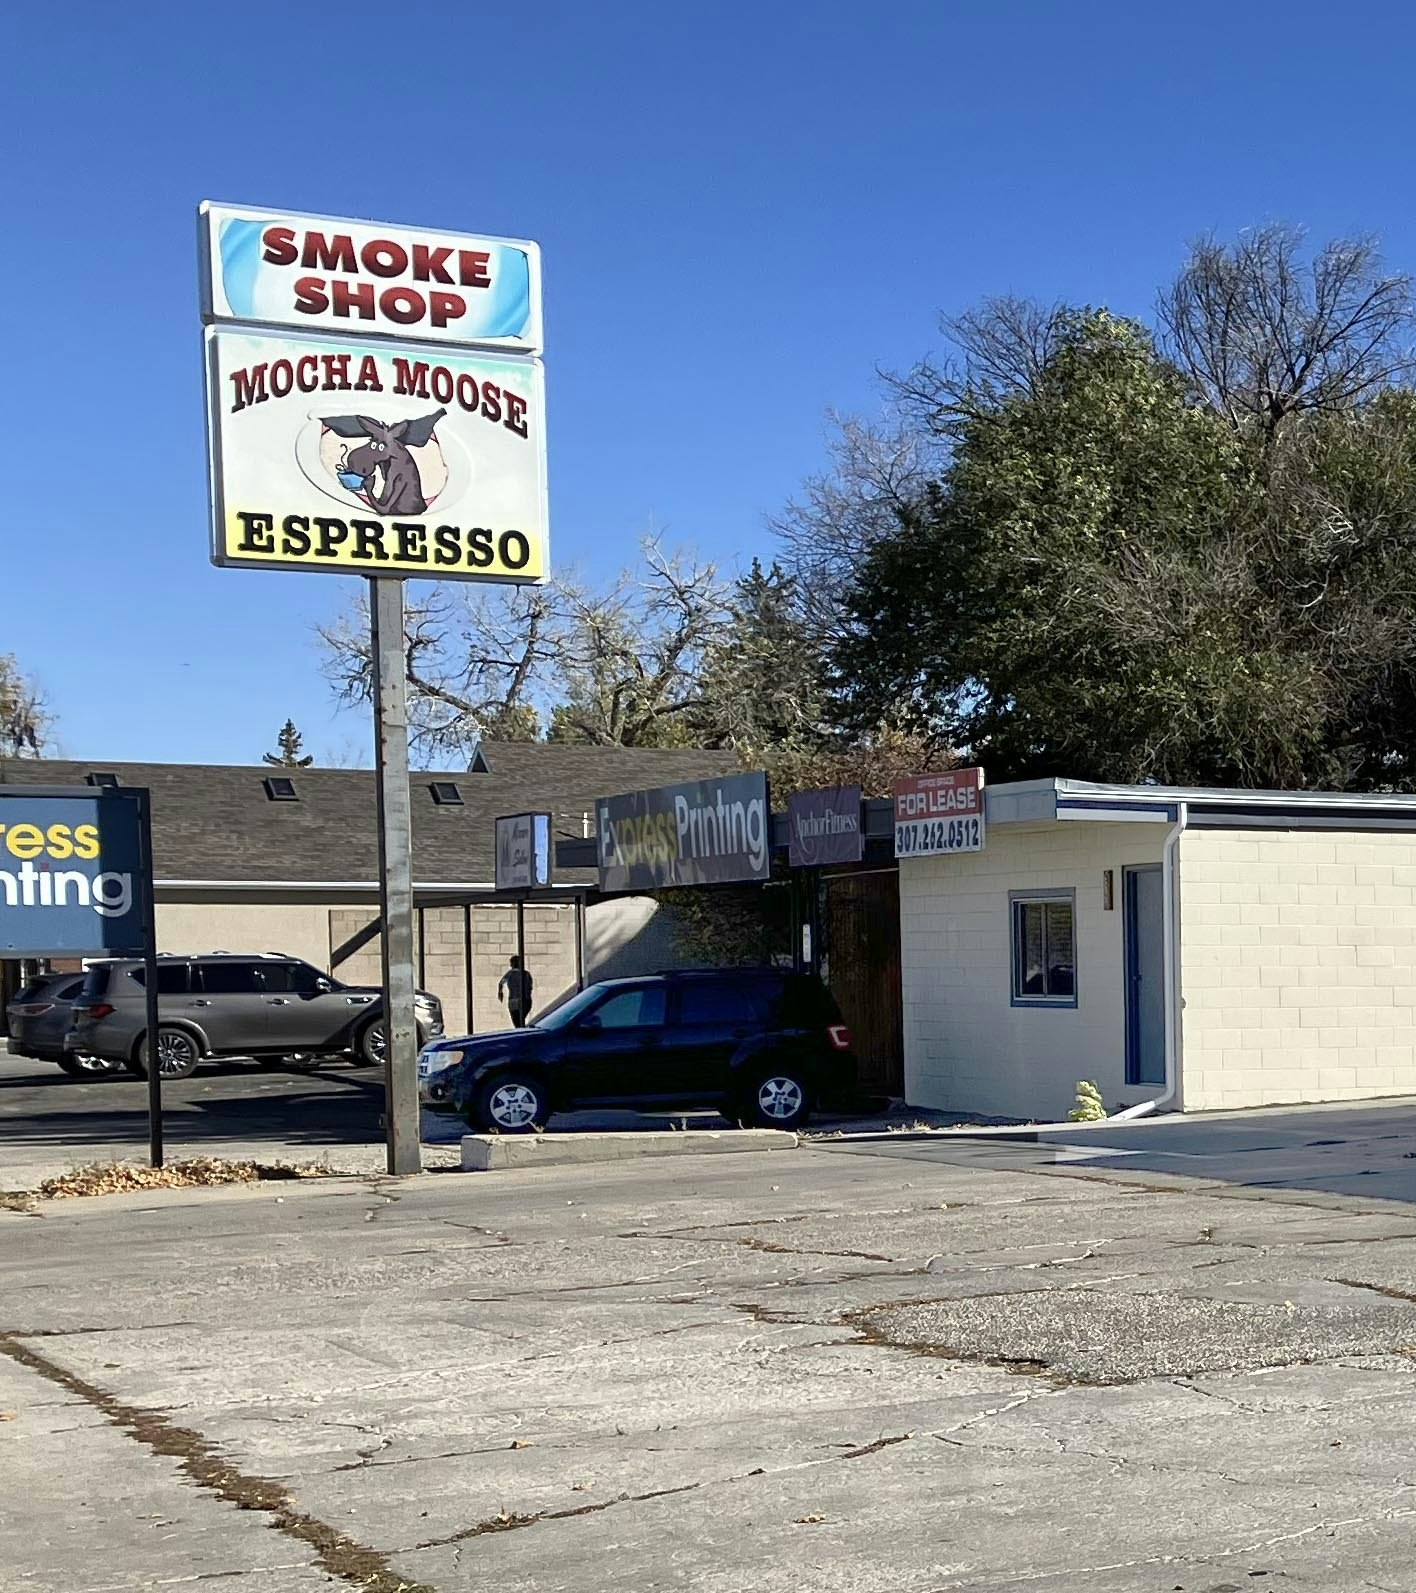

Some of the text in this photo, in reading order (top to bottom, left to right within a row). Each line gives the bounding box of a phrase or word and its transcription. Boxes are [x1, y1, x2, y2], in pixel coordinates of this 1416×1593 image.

[262, 227, 491, 288] SMOKE
[293, 276, 467, 328] SHOP
[230, 354, 528, 439] MOCHA MOOSE
[236, 511, 530, 570] ESPRESSO
[898, 786, 976, 816] FOR LEASE
[0, 824, 101, 860] ess
[897, 818, 979, 853] 307.262.0512
